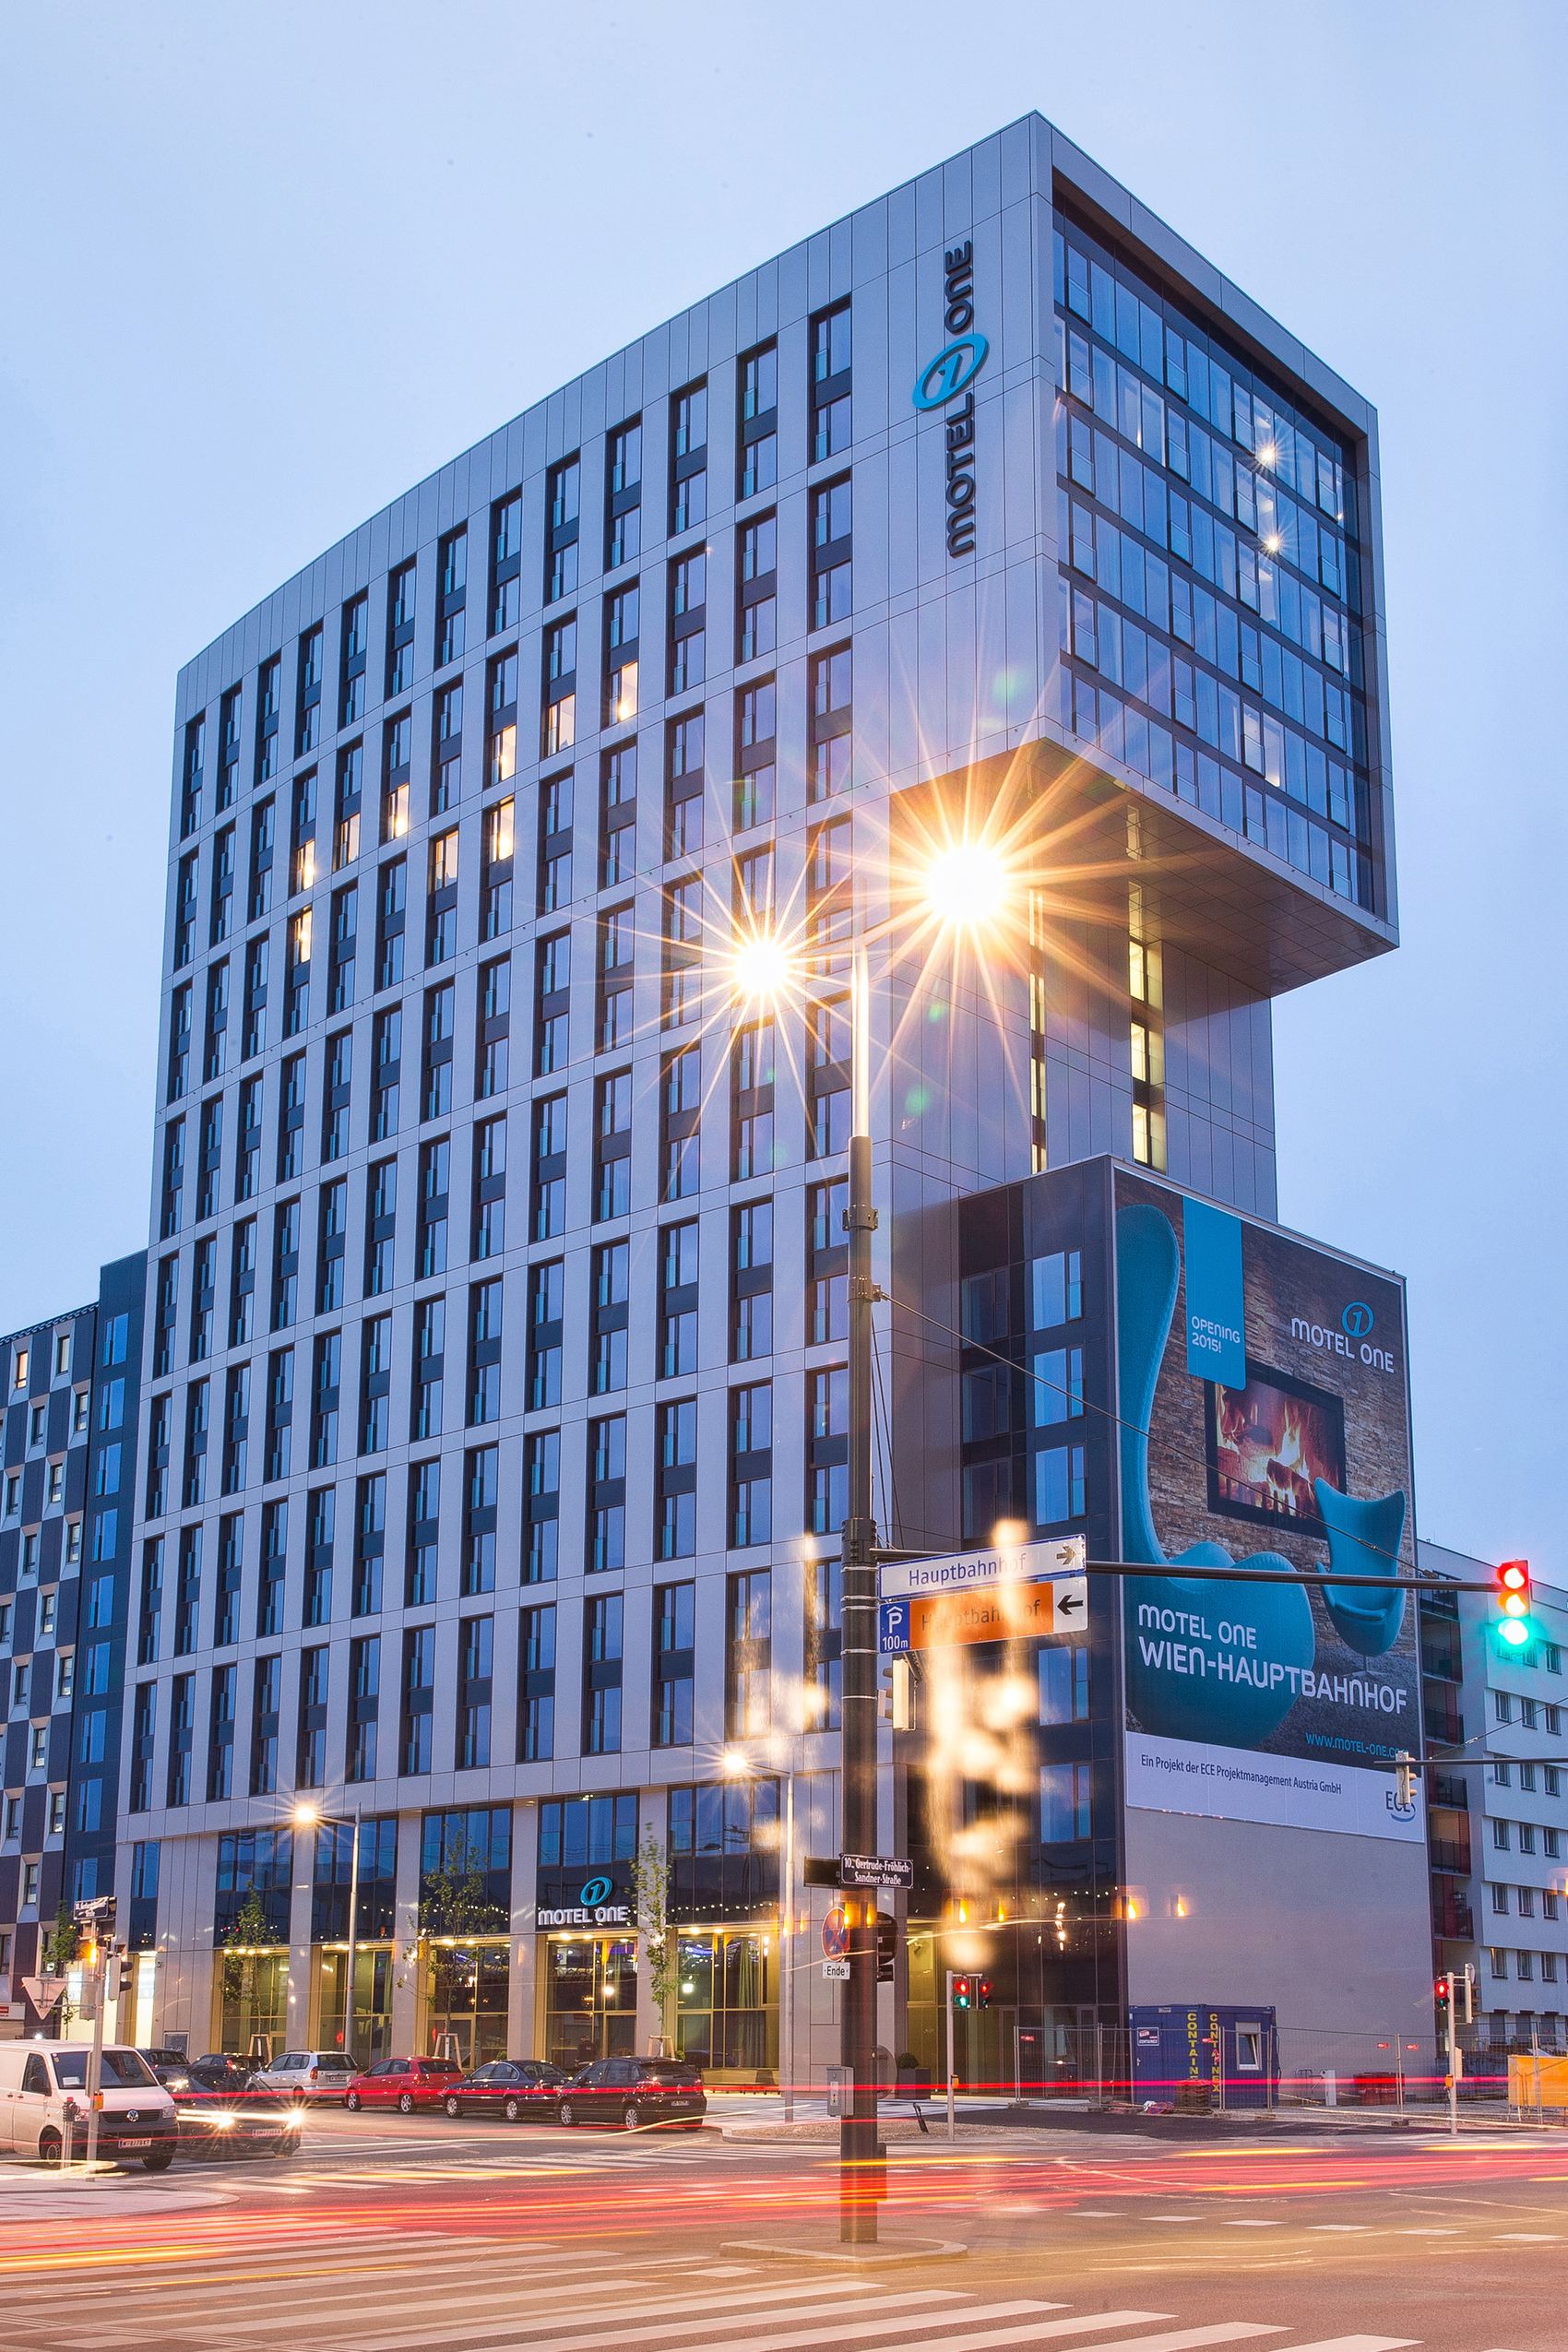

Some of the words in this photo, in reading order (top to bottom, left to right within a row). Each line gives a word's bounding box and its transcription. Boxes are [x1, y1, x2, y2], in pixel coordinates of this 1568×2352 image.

[1191, 1315, 1241, 1344] OPENING
[1192, 1332, 1222, 1354] 2015!
[909, 1553, 1027, 1587] Hauptbahnhof
[921, 1598, 1041, 1632] Hptbahof
[882, 1634, 909, 1652] 100m
[1137, 1635, 1408, 1715] WIEN-HAUPTBAHNHOF
[1141, 1754, 1154, 1767] Ein
[1156, 1756, 1184, 1773] Projekt
[1185, 1760, 1199, 1774] der
[1200, 1763, 1216, 1776] ECE
[1217, 1764, 1292, 1787] Projektmanagement
[1293, 1776, 1318, 1791] Austria
[1319, 1780, 1342, 1794] GmbH
[1385, 1790, 1411, 1813] EC
[855, 1858, 911, 1873] Gertrude-Fröhlich-
[854, 1871, 902, 1885] Sandner-Straße
[826, 1965, 846, 1977] Ende
